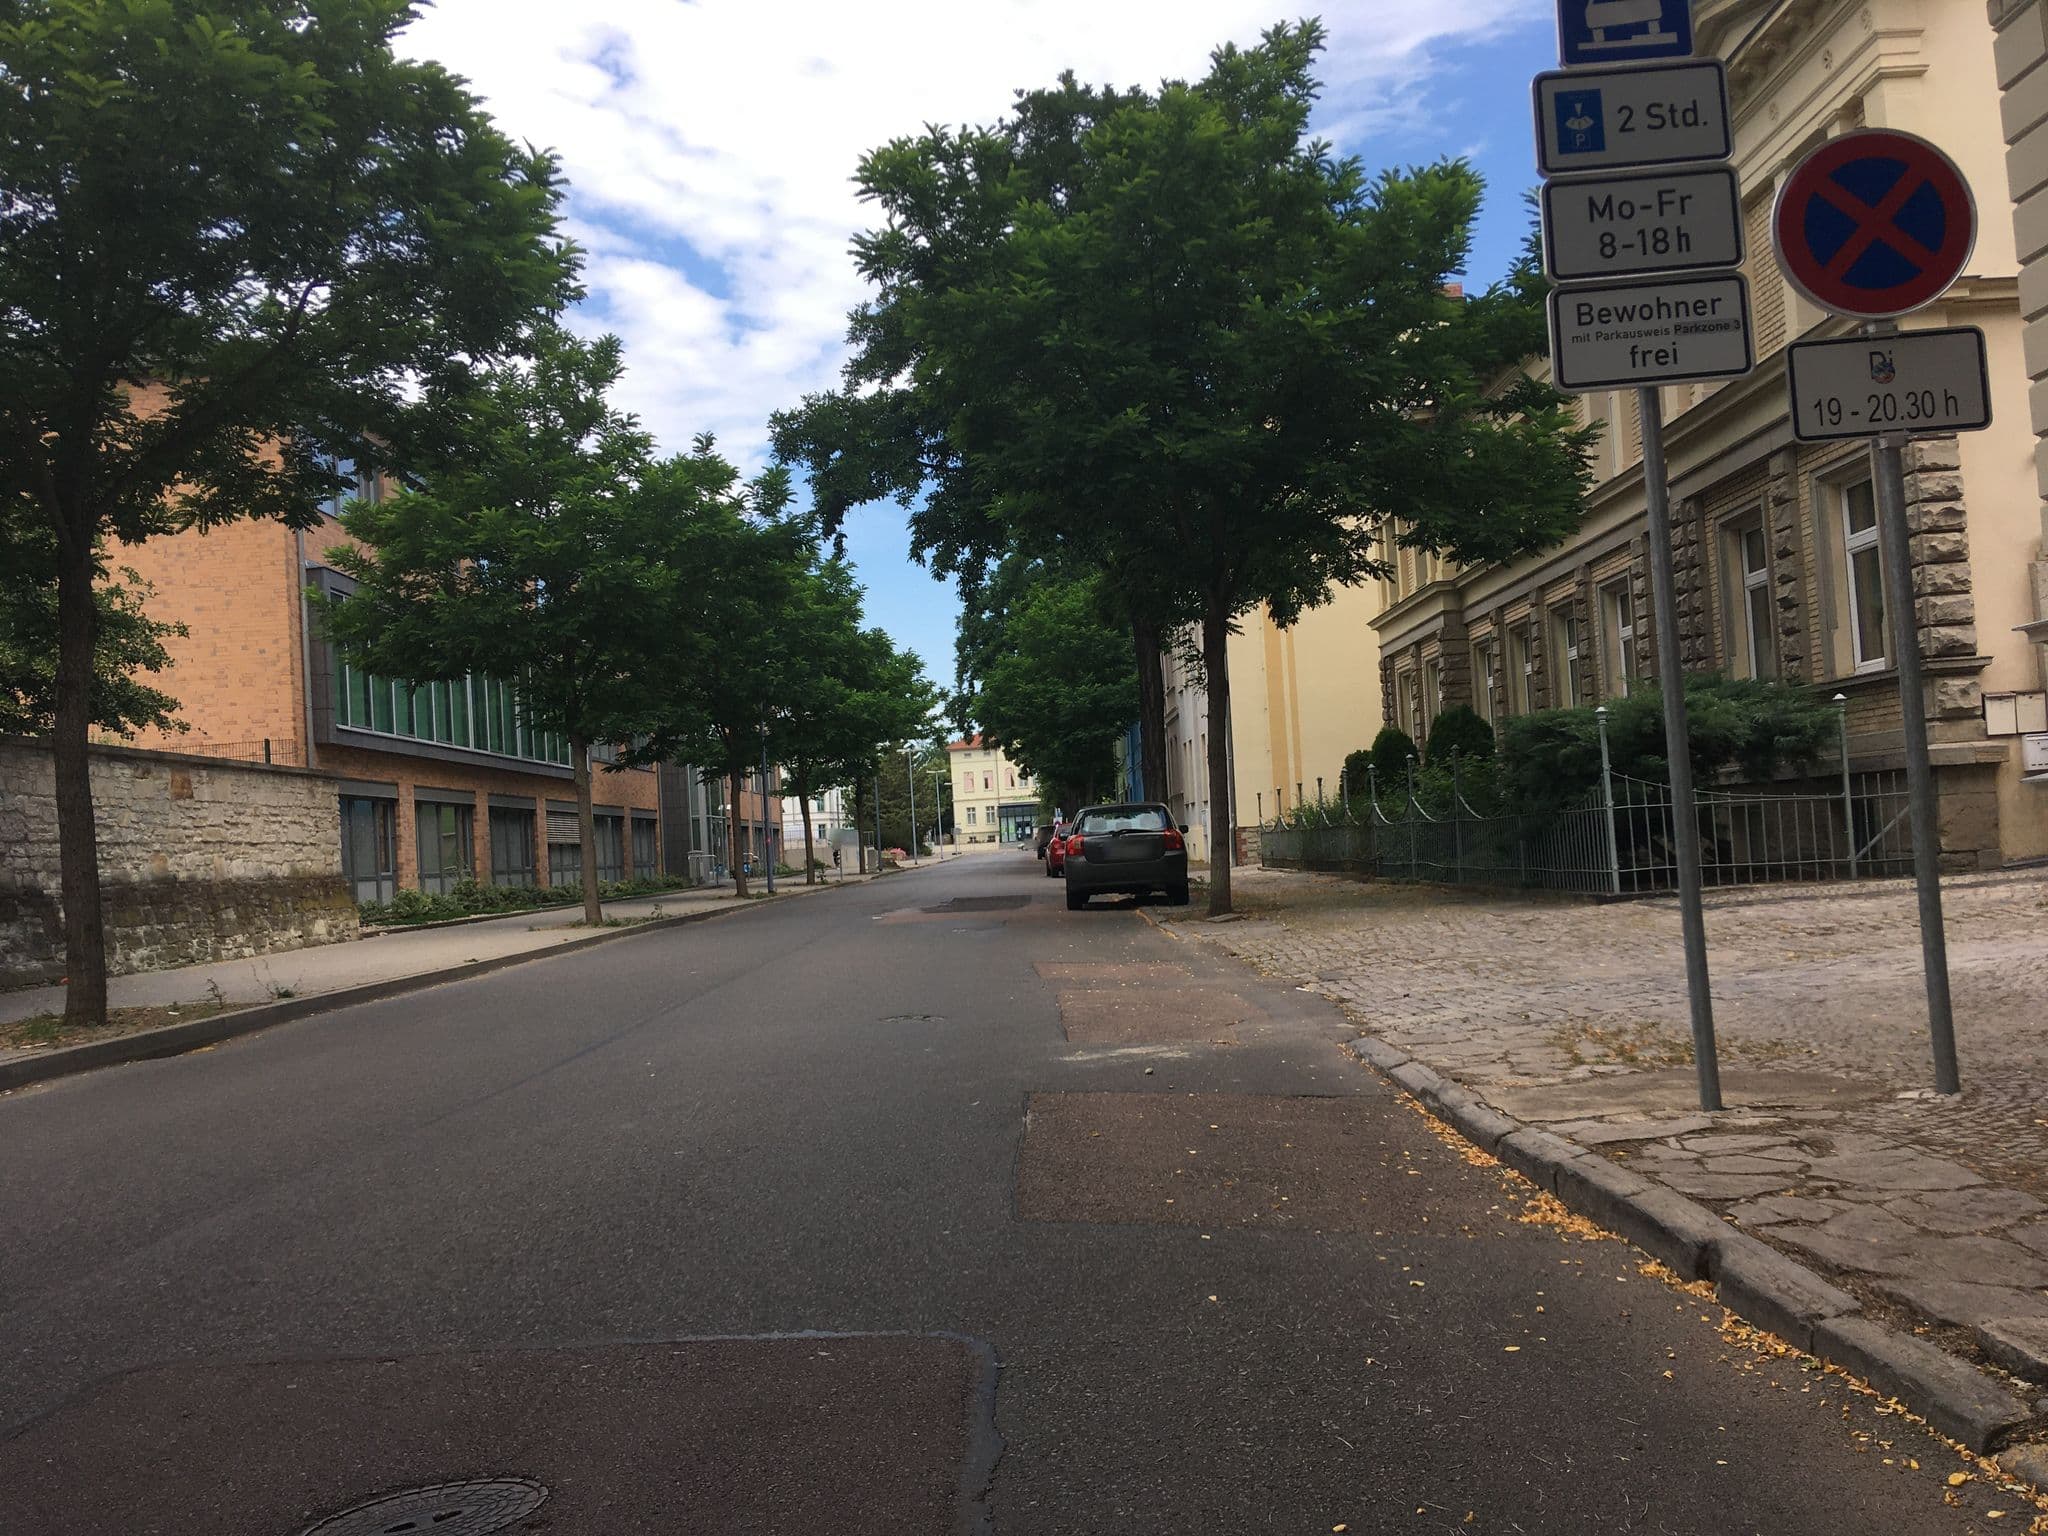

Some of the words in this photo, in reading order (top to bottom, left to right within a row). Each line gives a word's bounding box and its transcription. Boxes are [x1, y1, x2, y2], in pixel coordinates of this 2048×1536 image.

[1617, 105, 1635, 133] 2
[1646, 99, 1708, 130] Std.
[1587, 189, 1693, 223] Mo-Fr
[1576, 297, 1722, 326] Bewohner
[1571, 333, 1591, 344] mit
[1595, 326, 1670, 342] Parkausweis
[1674, 321, 1730, 336] Parkzone
[1734, 319, 1741, 330] 3
[1630, 342, 1679, 368] frei
[1814, 397, 1842, 426] 19
[1867, 390, 1935, 423] 20.30
[1944, 388, 1959, 416] h
